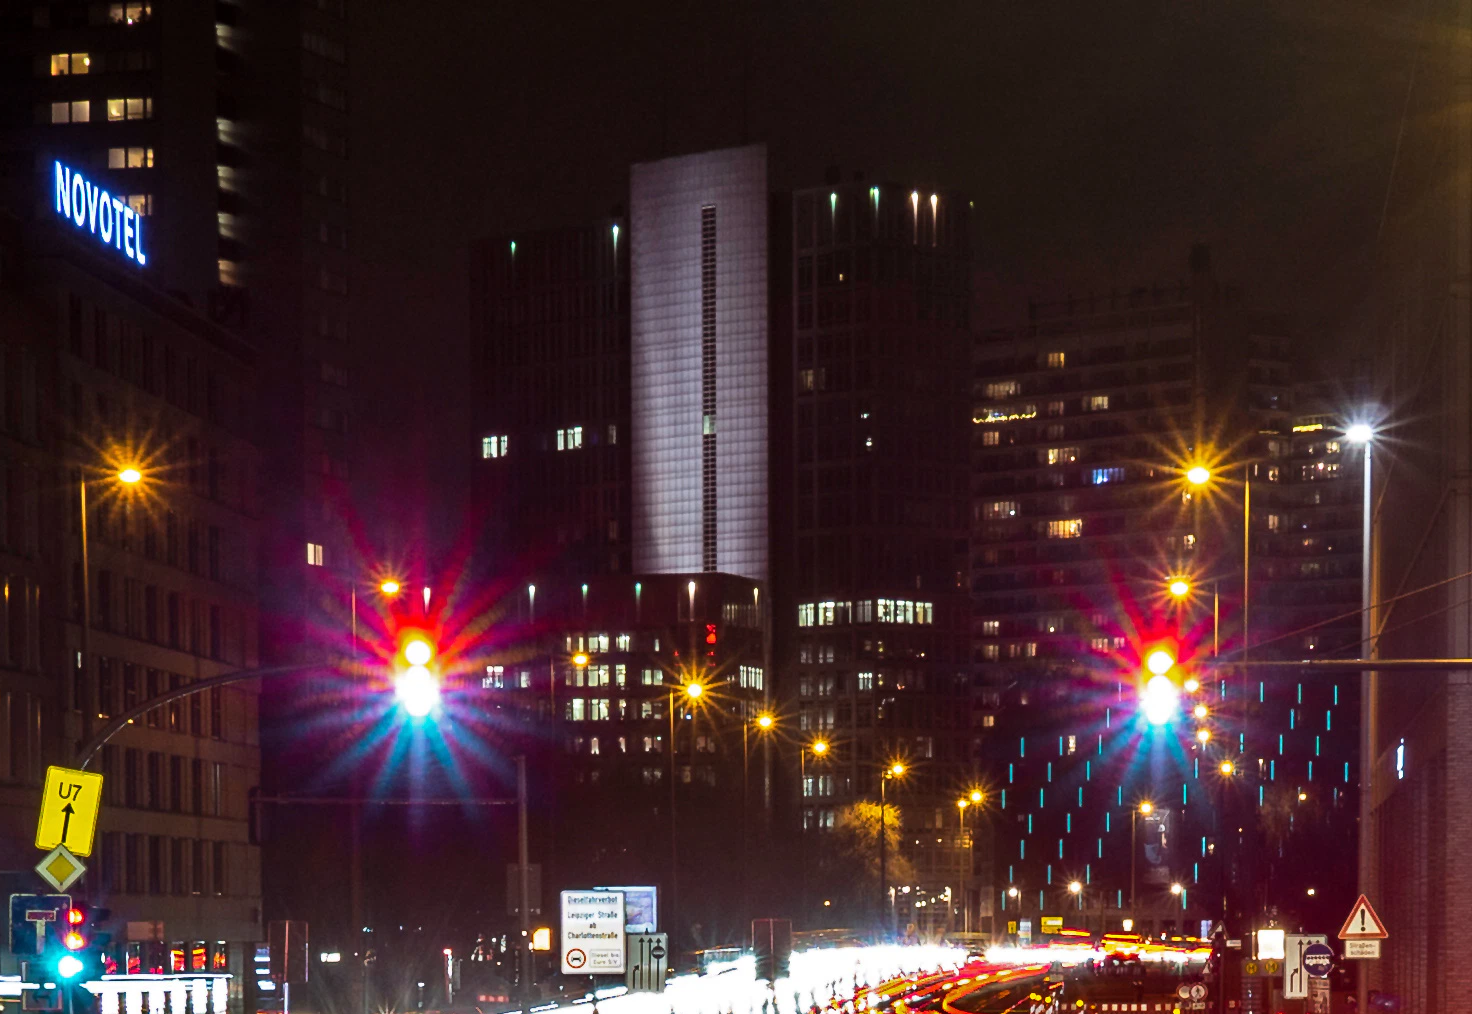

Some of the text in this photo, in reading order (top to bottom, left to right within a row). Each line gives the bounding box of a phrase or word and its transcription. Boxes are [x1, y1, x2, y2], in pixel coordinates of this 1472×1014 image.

[54, 160, 147, 266] NOVOTEL
[58, 781, 82, 801] U7
[568, 896, 618, 904] Dieselfahrverbot
[568, 911, 618, 920] Leipziger Straße
[568, 931, 618, 940] Charlottenstraße
